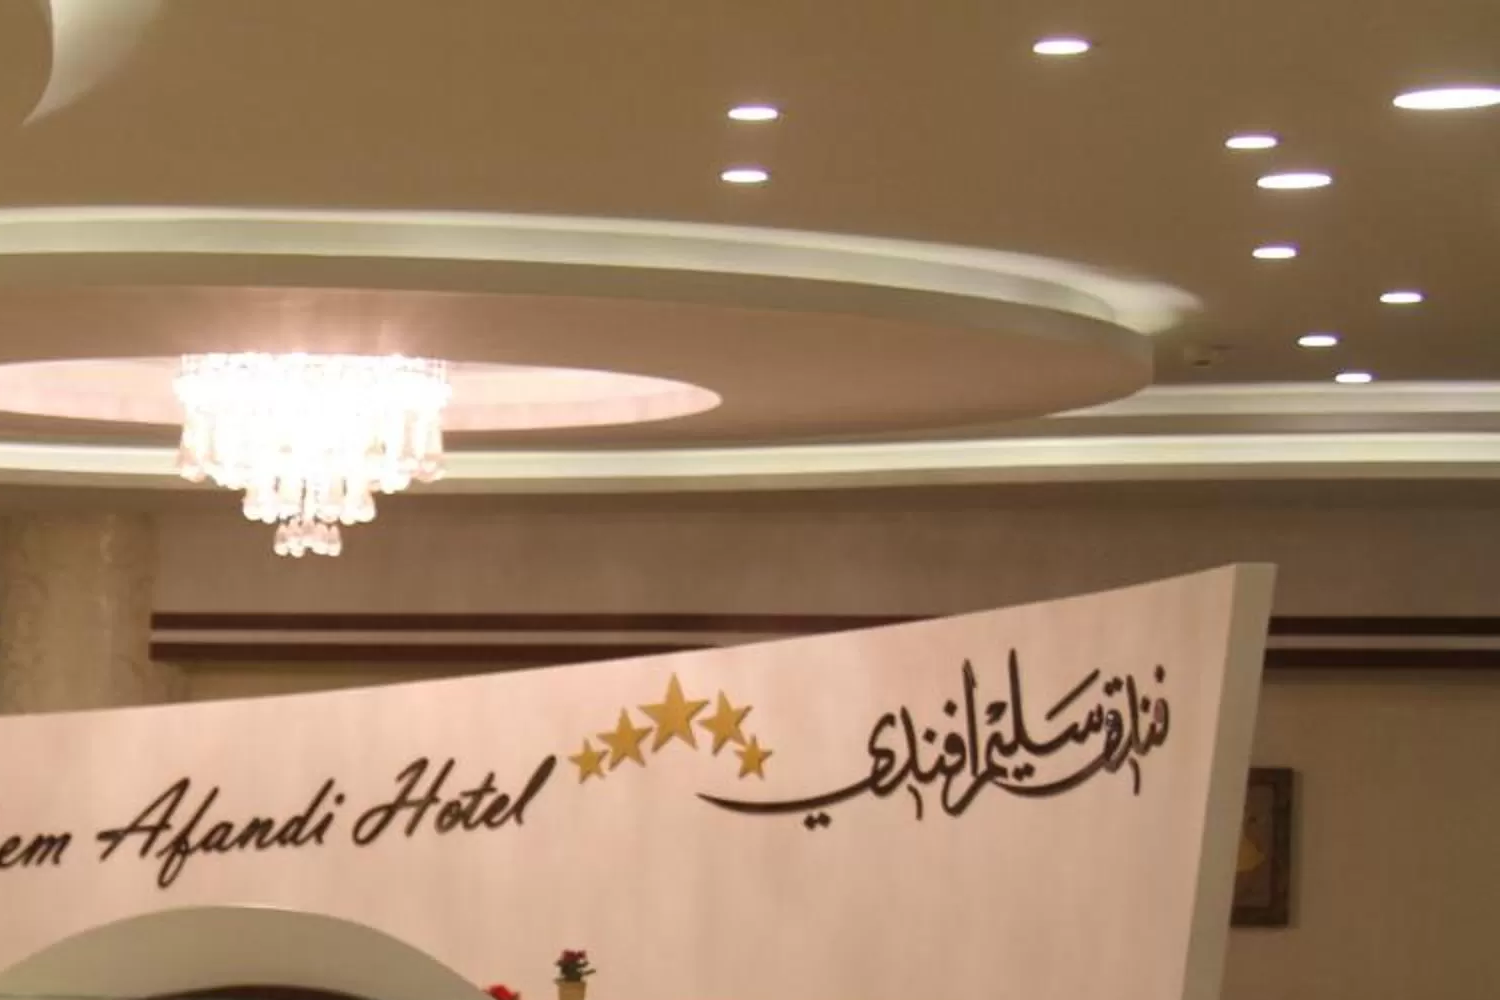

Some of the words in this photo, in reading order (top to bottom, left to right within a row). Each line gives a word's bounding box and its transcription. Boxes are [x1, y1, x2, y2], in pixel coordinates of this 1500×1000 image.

[990, 664, 1171, 798] فندق
[95, 777, 346, 889] Afandi
[351, 754, 558, 846] Hotel
